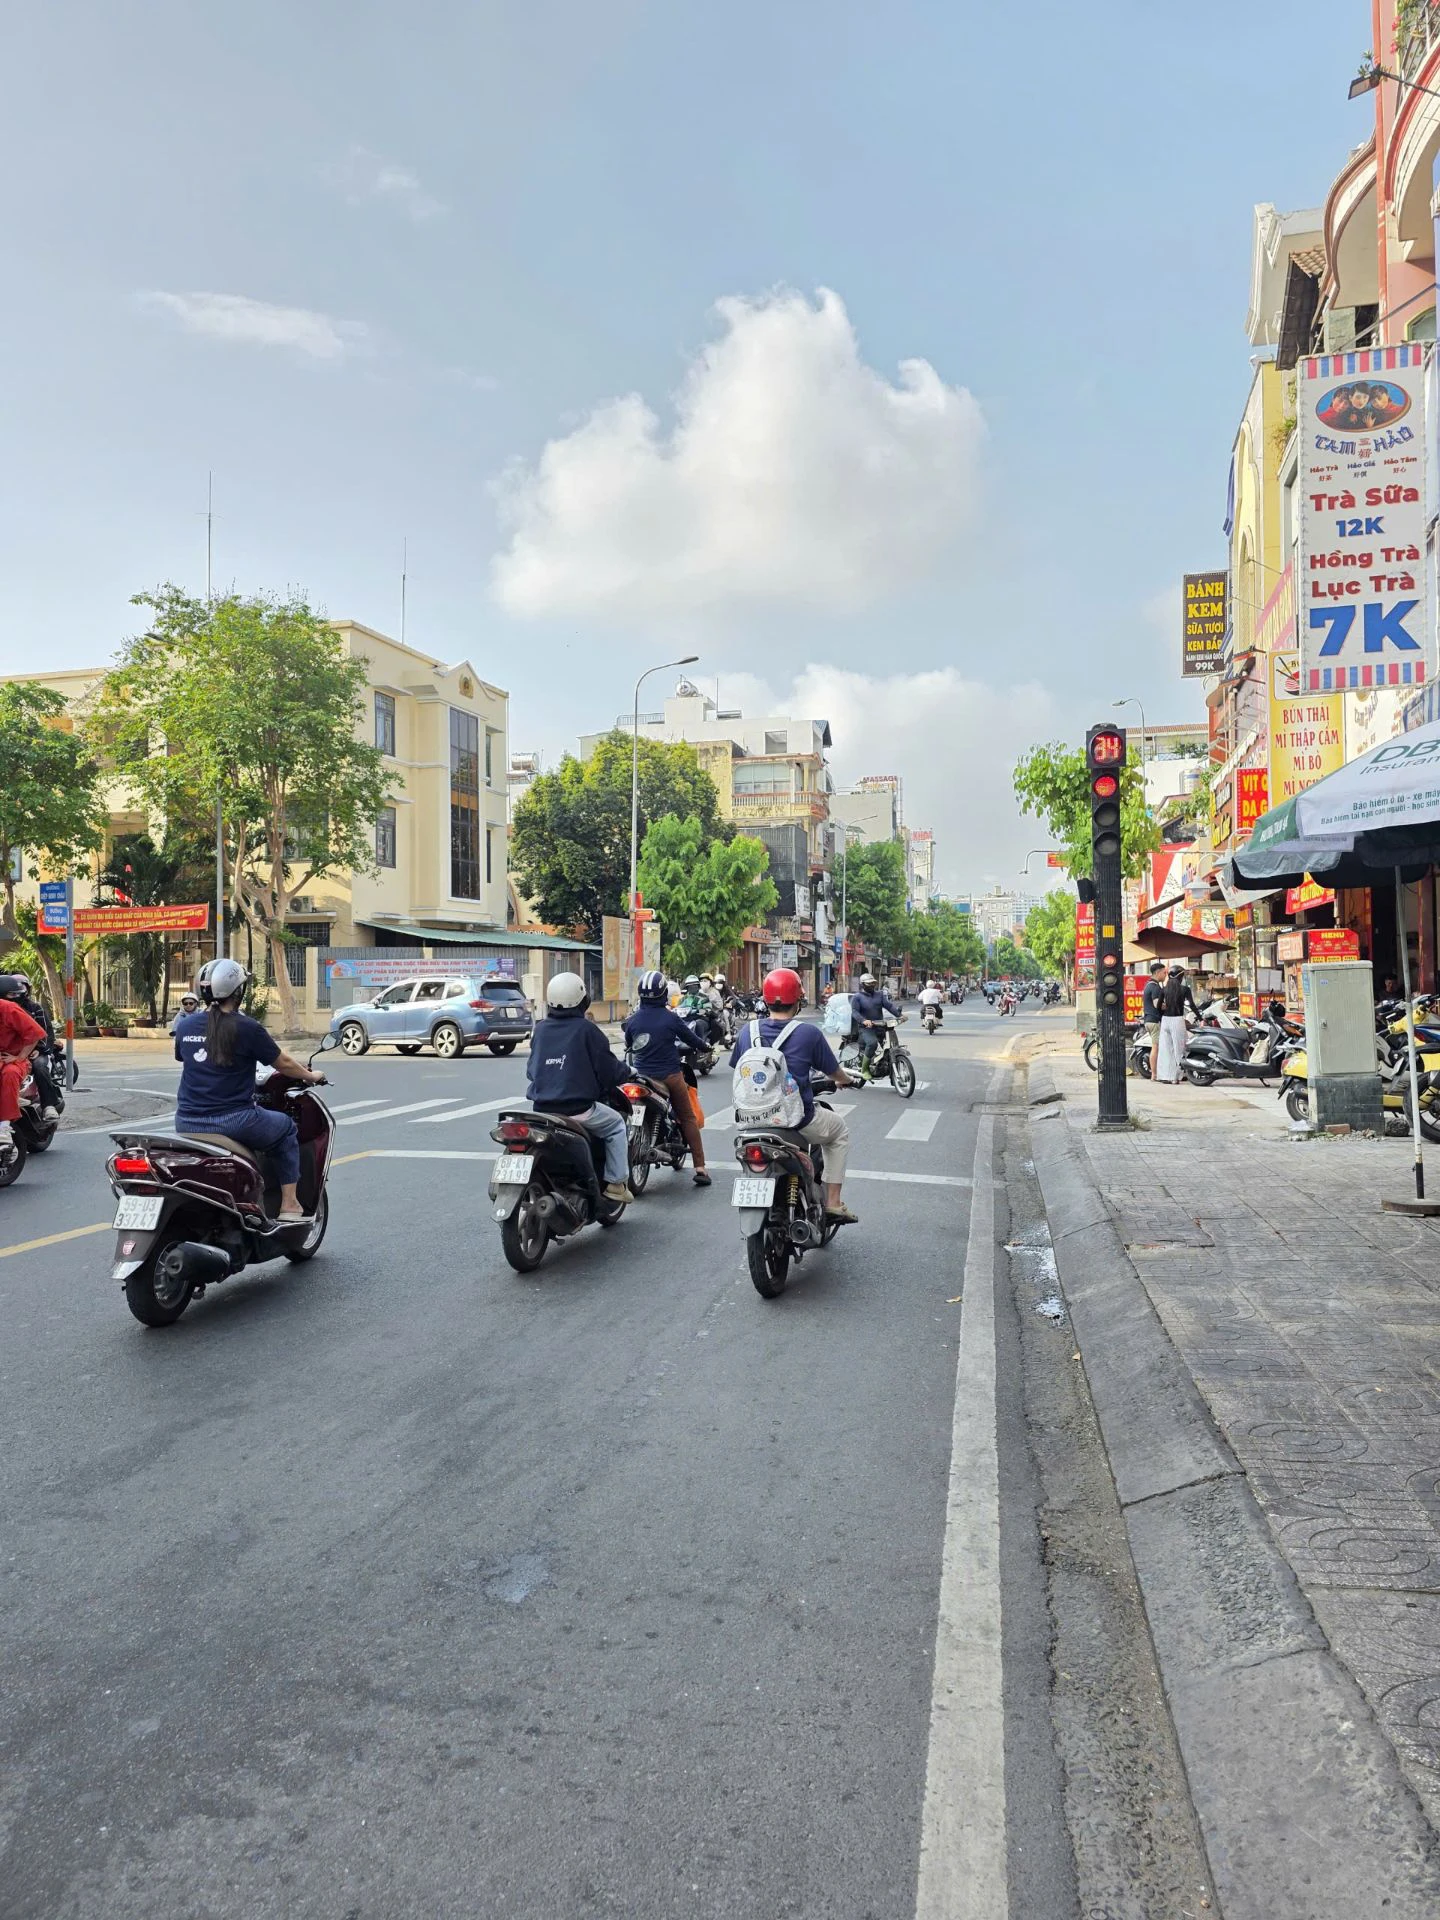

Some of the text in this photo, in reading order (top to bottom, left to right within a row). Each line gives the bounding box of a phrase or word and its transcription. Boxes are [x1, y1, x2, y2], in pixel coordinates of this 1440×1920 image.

[1374, 426, 1414, 452] HẢO
[1326, 464, 1338, 472] Trà
[1310, 484, 1419, 512] Trà Sữa
[1336, 516, 1385, 538] 12K
[1310, 544, 1420, 570] Hồng Trà
[1186, 580, 1224, 598] BÁNH
[1312, 572, 1416, 601] Lục Trà
[1187, 602, 1224, 618] KEM
[1186, 621, 1224, 635] SỮA TƯƠI
[1310, 600, 1422, 656] 7K
[1187, 640, 1204, 652] KEM
[1195, 662, 1214, 670] 99K
[1282, 702, 1330, 724] BÚN THÁI
[1275, 730, 1286, 749] MÌ
[1290, 728, 1316, 751] THẬP
[1293, 751, 1322, 772] MÌ BÒ
[1242, 774, 1259, 796] VỊT
[1284, 776, 1296, 796] MÌ
[1413, 792, 1422, 801] xe
[1242, 799, 1258, 818] DA
[1351, 811, 1360, 820] tai
[1412, 801, 1425, 812] học
[1426, 798, 1440, 808] sinh
[740, 1180, 768, 1192] 54-L4
[738, 1192, 767, 1205] 3511
[116, 1213, 156, 1228] 337.47
